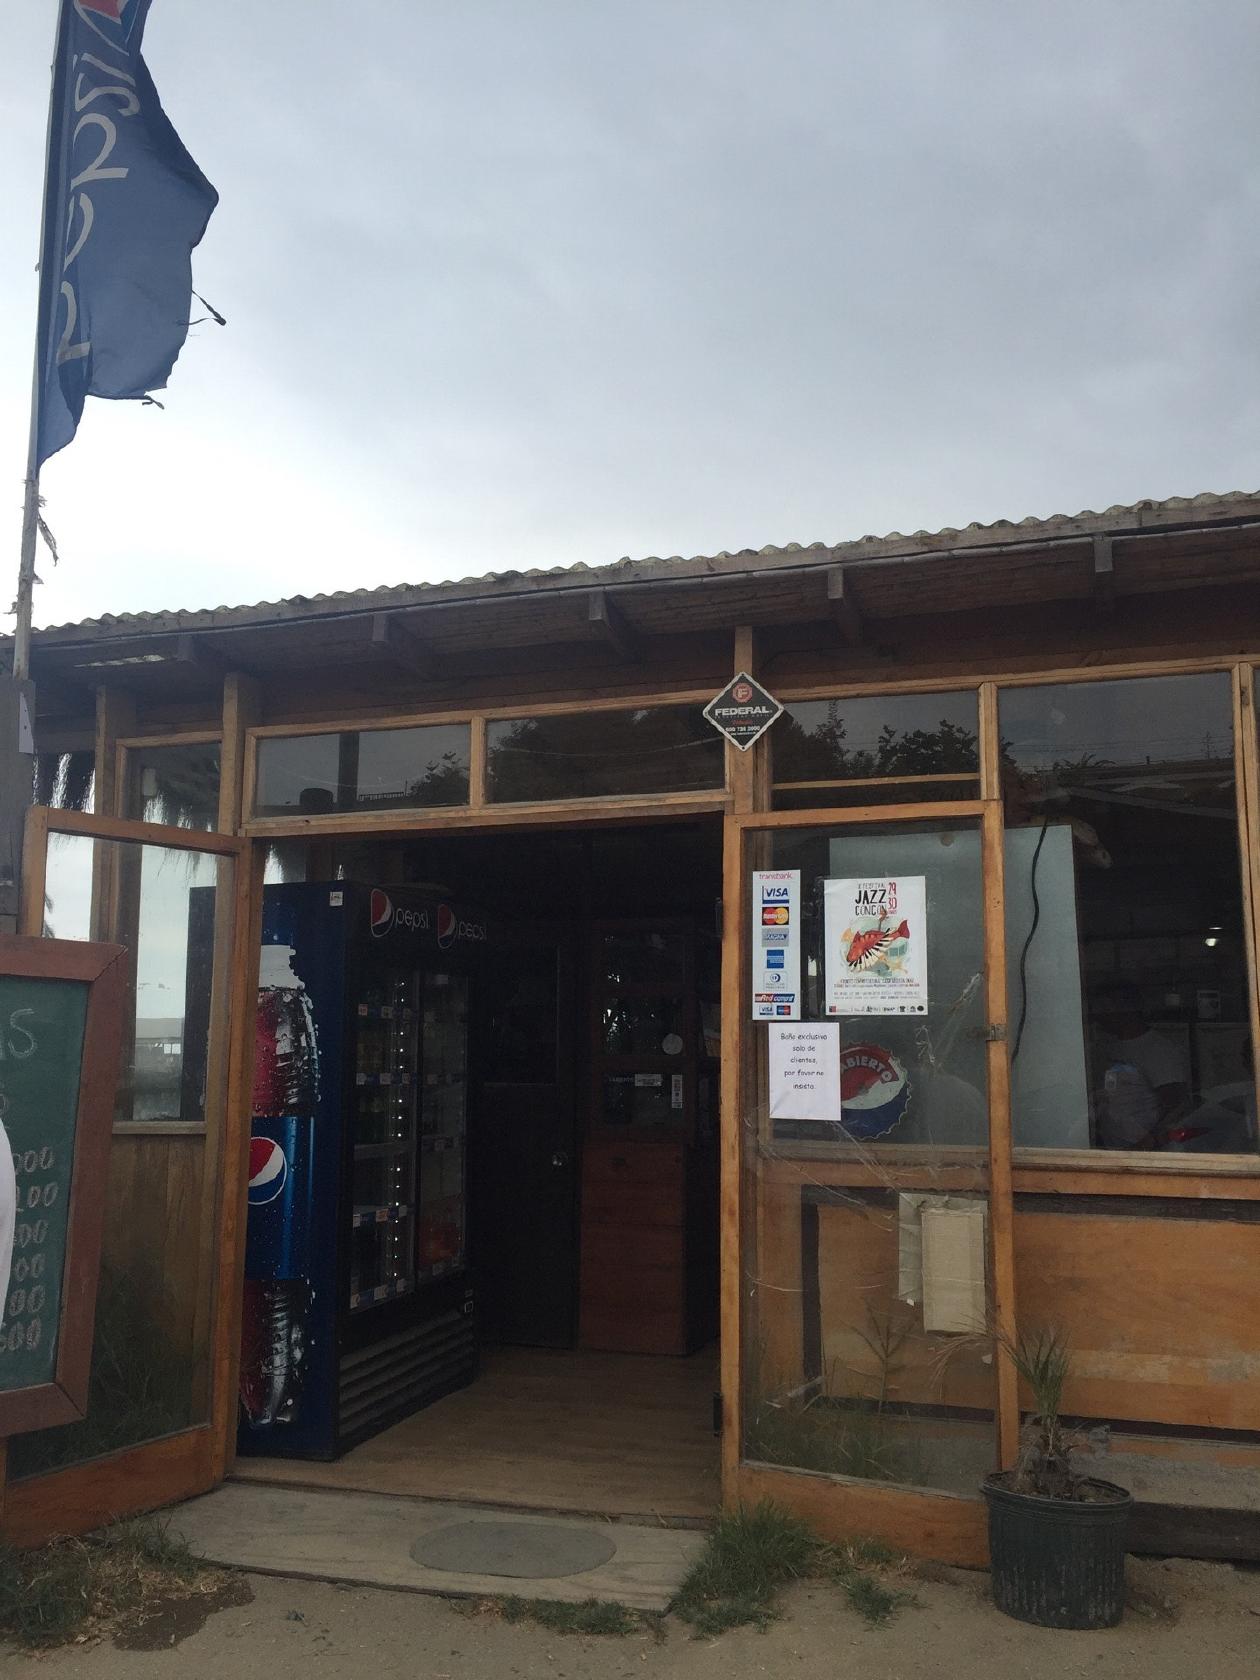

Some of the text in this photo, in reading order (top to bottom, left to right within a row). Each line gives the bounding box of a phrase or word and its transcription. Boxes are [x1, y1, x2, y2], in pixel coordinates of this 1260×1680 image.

[714, 706, 770, 716] FEDERAL
[759, 872, 793, 880] transbank
[765, 887, 789, 897] VISA
[888, 882, 897, 895] 29
[855, 889, 887, 904] JAZZ
[888, 897, 897, 909] 30
[395, 908, 430, 931] pepsi
[797, 1032, 828, 1040] exclusivo
[784, 1070, 796, 1078] por
[797, 1069, 816, 1077] favor
